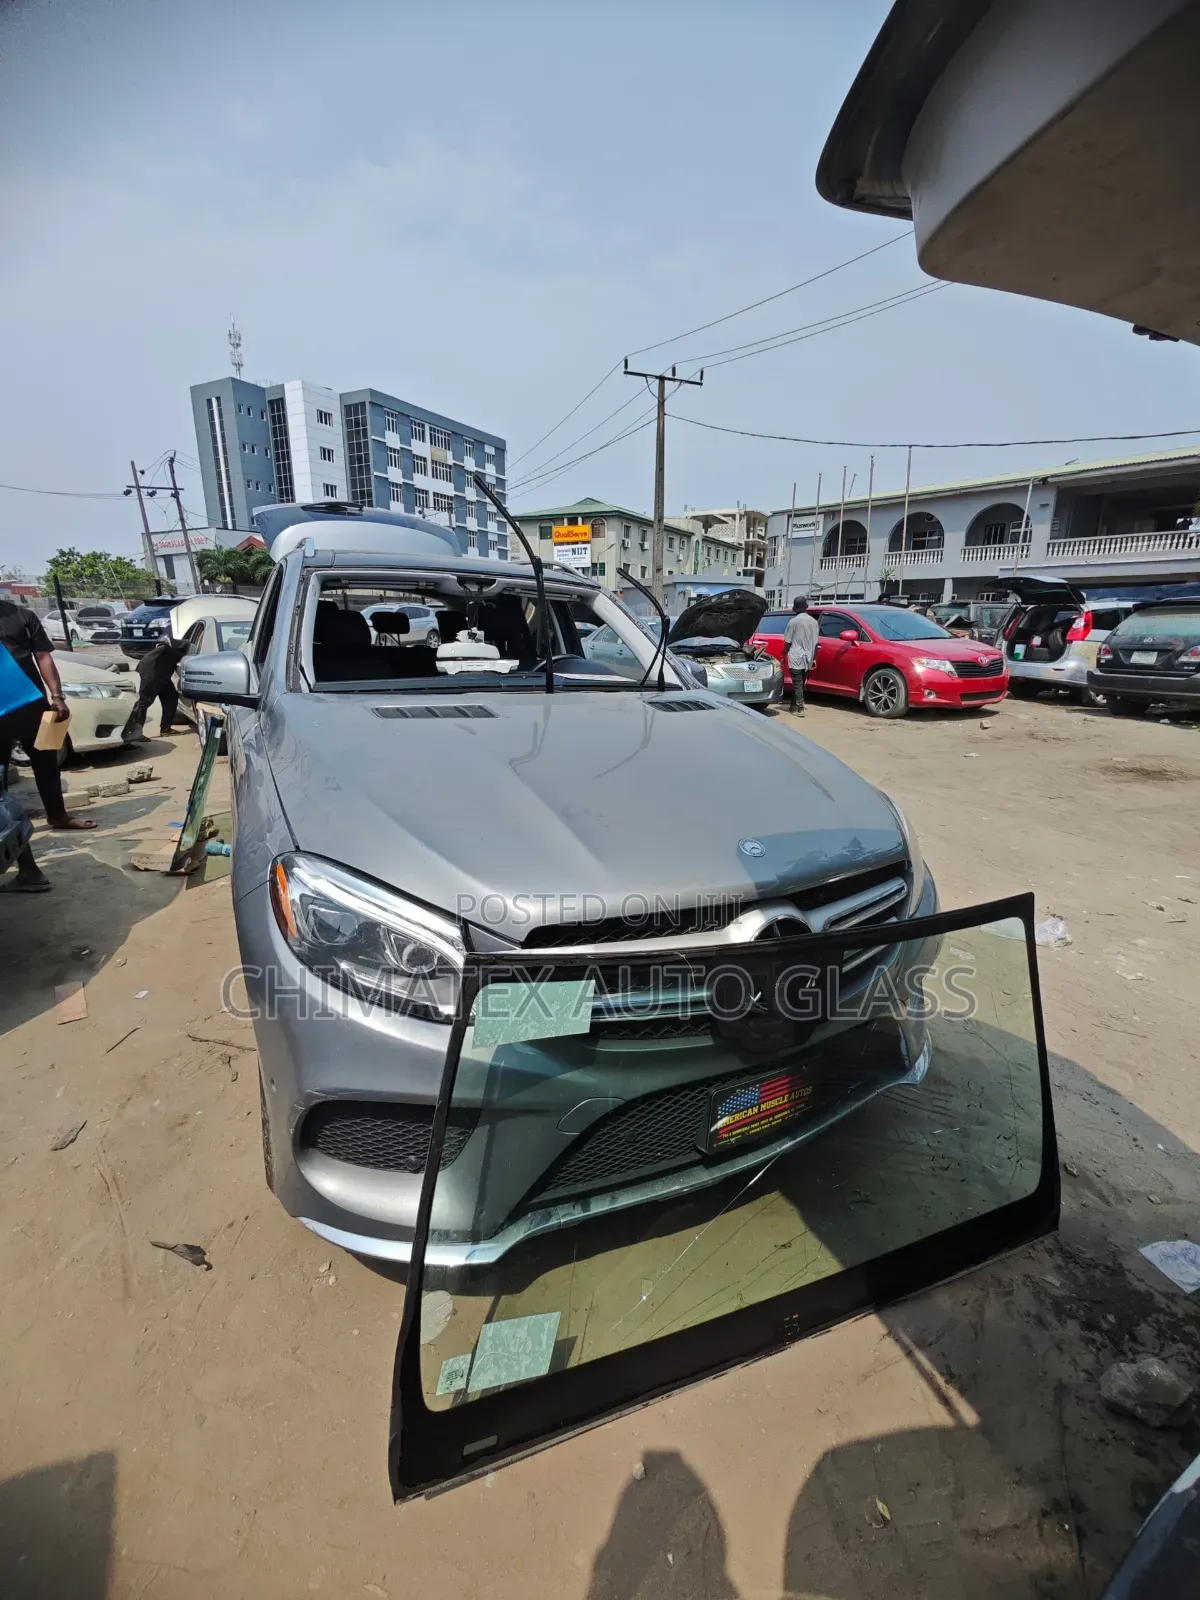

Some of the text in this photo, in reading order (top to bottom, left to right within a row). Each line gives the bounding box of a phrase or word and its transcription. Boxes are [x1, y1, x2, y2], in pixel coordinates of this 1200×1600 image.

[554, 530, 588, 539] QualiServe
[571, 547, 588, 556] NIIT
[717, 1105, 760, 1129] AMERICAN
[760, 1094, 789, 1113] MUSCLE
[789, 1086, 813, 1101] AUTOS
